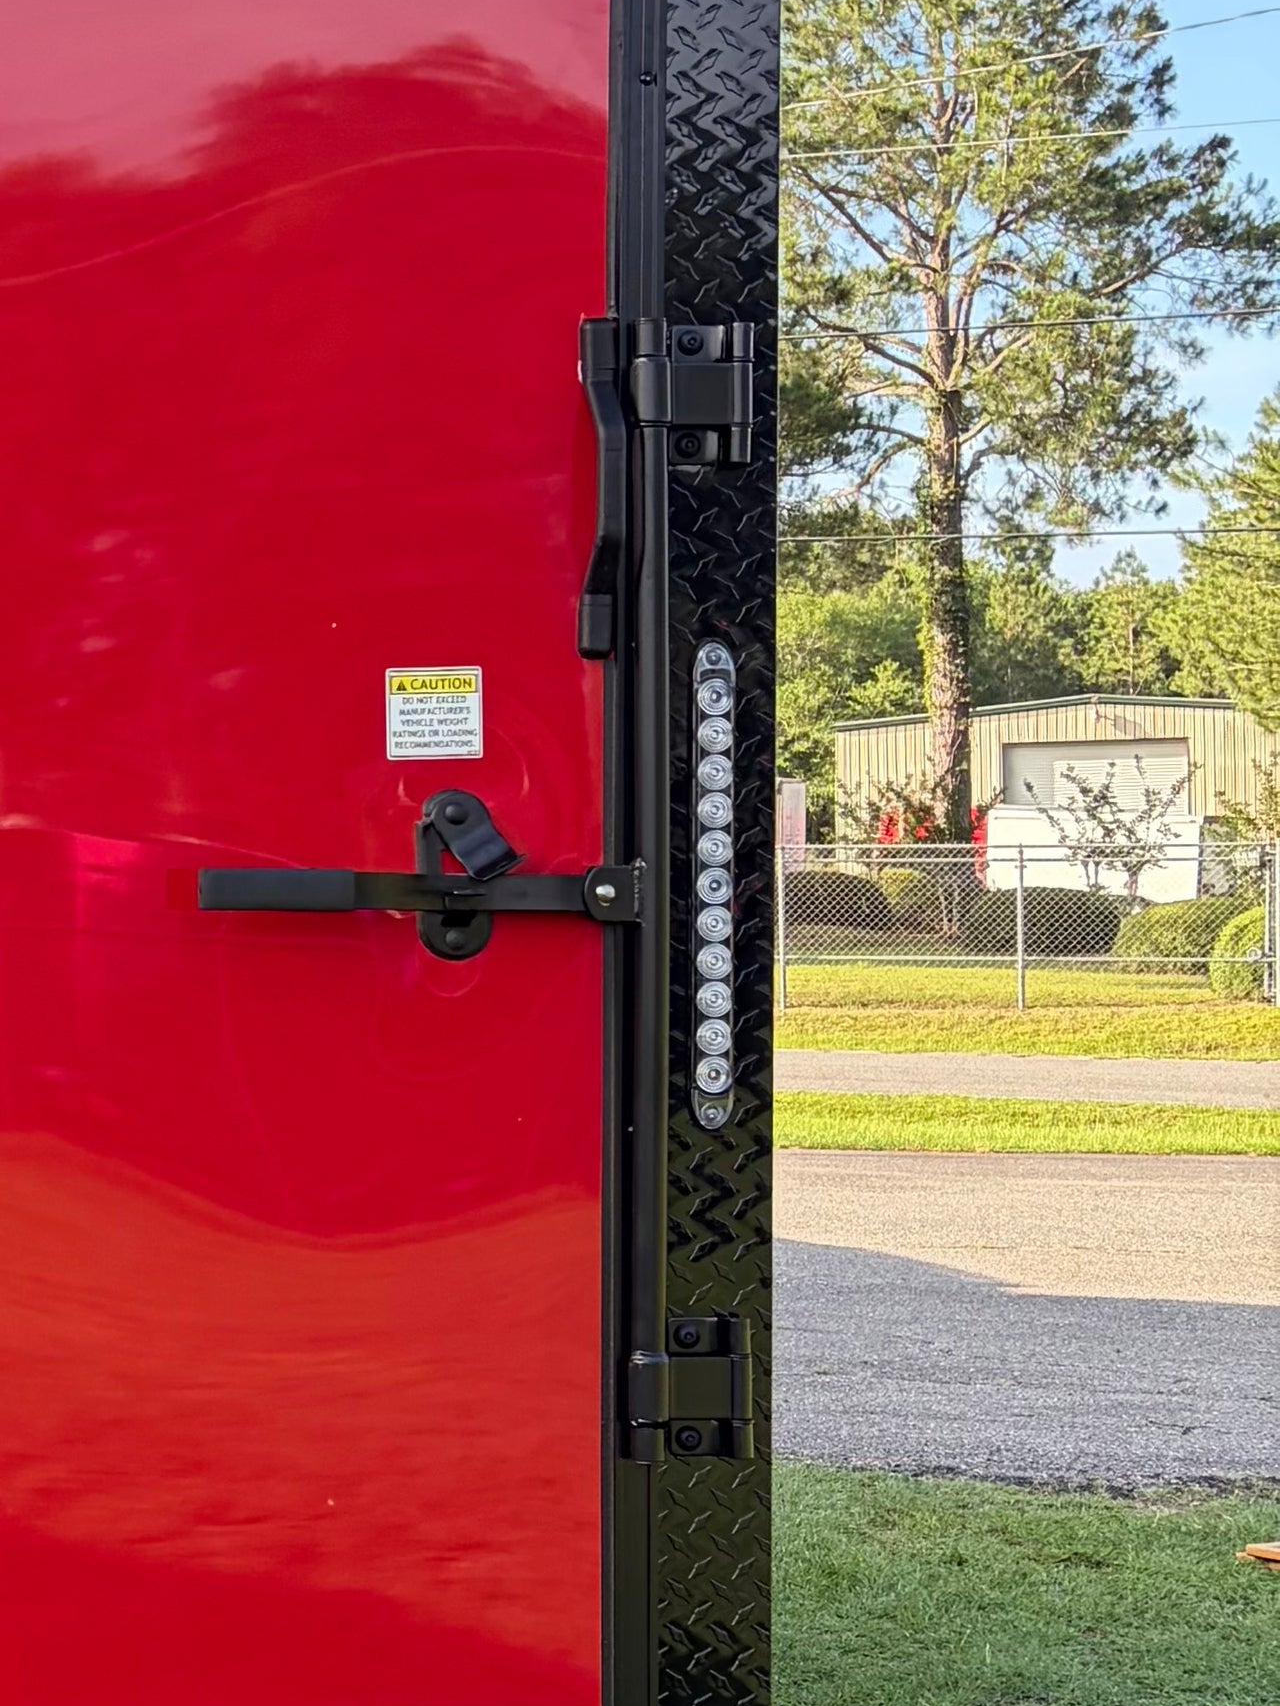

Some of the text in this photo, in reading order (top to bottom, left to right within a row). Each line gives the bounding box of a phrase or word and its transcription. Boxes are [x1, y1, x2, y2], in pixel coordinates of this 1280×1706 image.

[410, 678, 472, 690] CAUTION
[402, 695, 467, 705] DO NOT EXCEED
[401, 718, 434, 727] VEHICLE
[442, 729, 478, 738] LOADING
